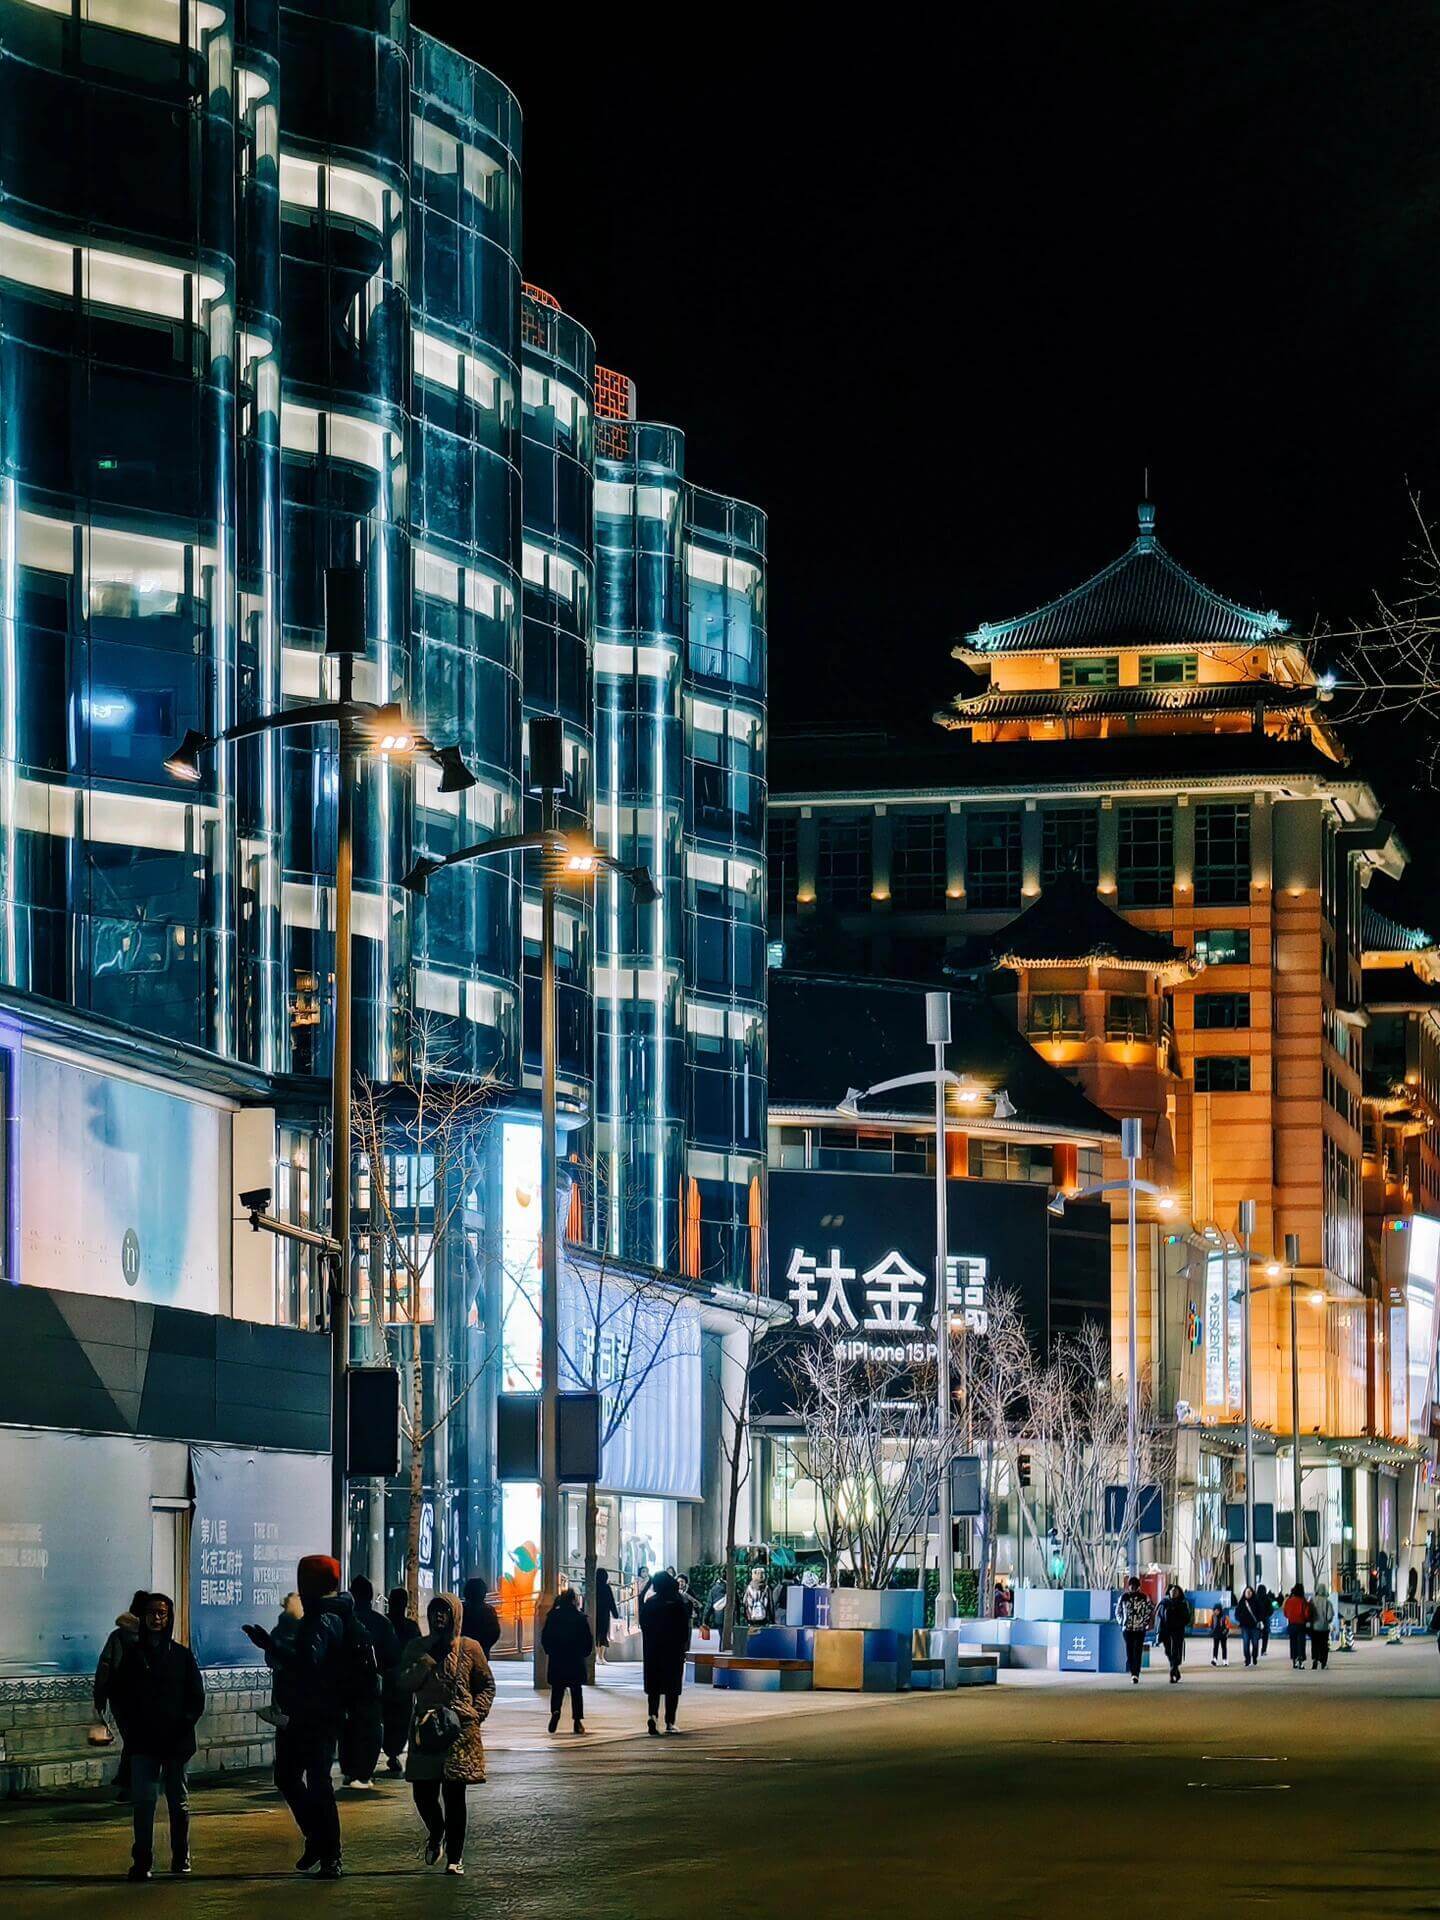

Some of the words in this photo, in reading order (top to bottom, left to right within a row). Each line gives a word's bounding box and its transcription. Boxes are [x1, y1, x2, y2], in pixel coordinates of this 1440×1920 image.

[1209, 1303, 1221, 1363] DESCENTE
[848, 1341, 905, 1362] iPhone
[906, 1343, 925, 1363] 15
[200, 1579, 243, 1606] 国际品牌节
